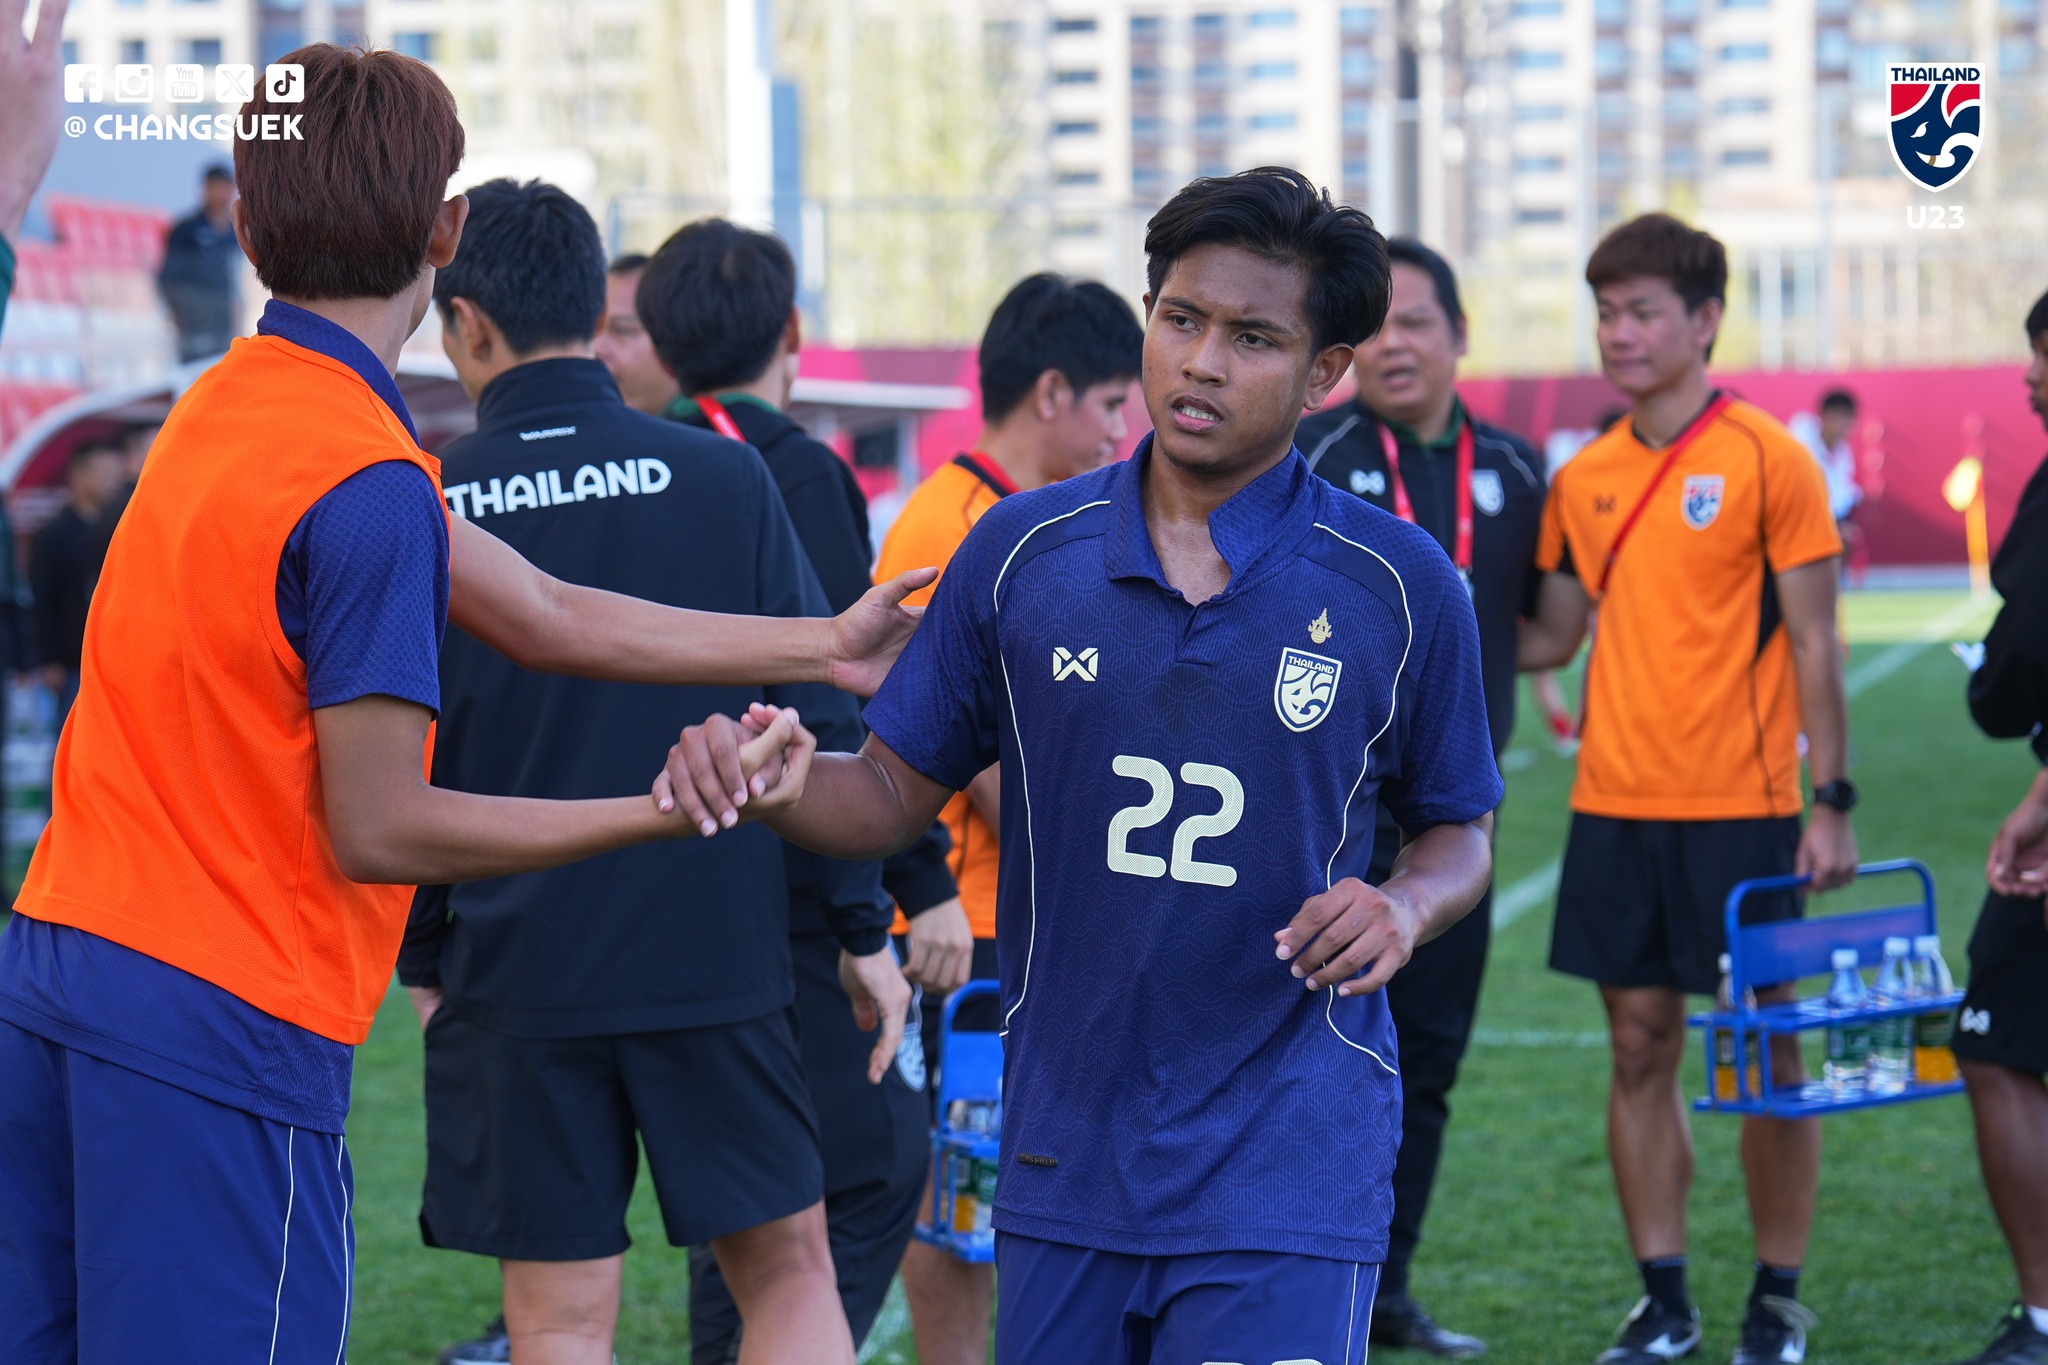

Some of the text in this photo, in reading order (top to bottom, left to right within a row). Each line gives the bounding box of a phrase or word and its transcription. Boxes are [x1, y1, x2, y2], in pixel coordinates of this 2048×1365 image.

[444, 458, 672, 519] THAILAND
[1288, 655, 1335, 675] THAILAND
[1107, 755, 1245, 887] 22
